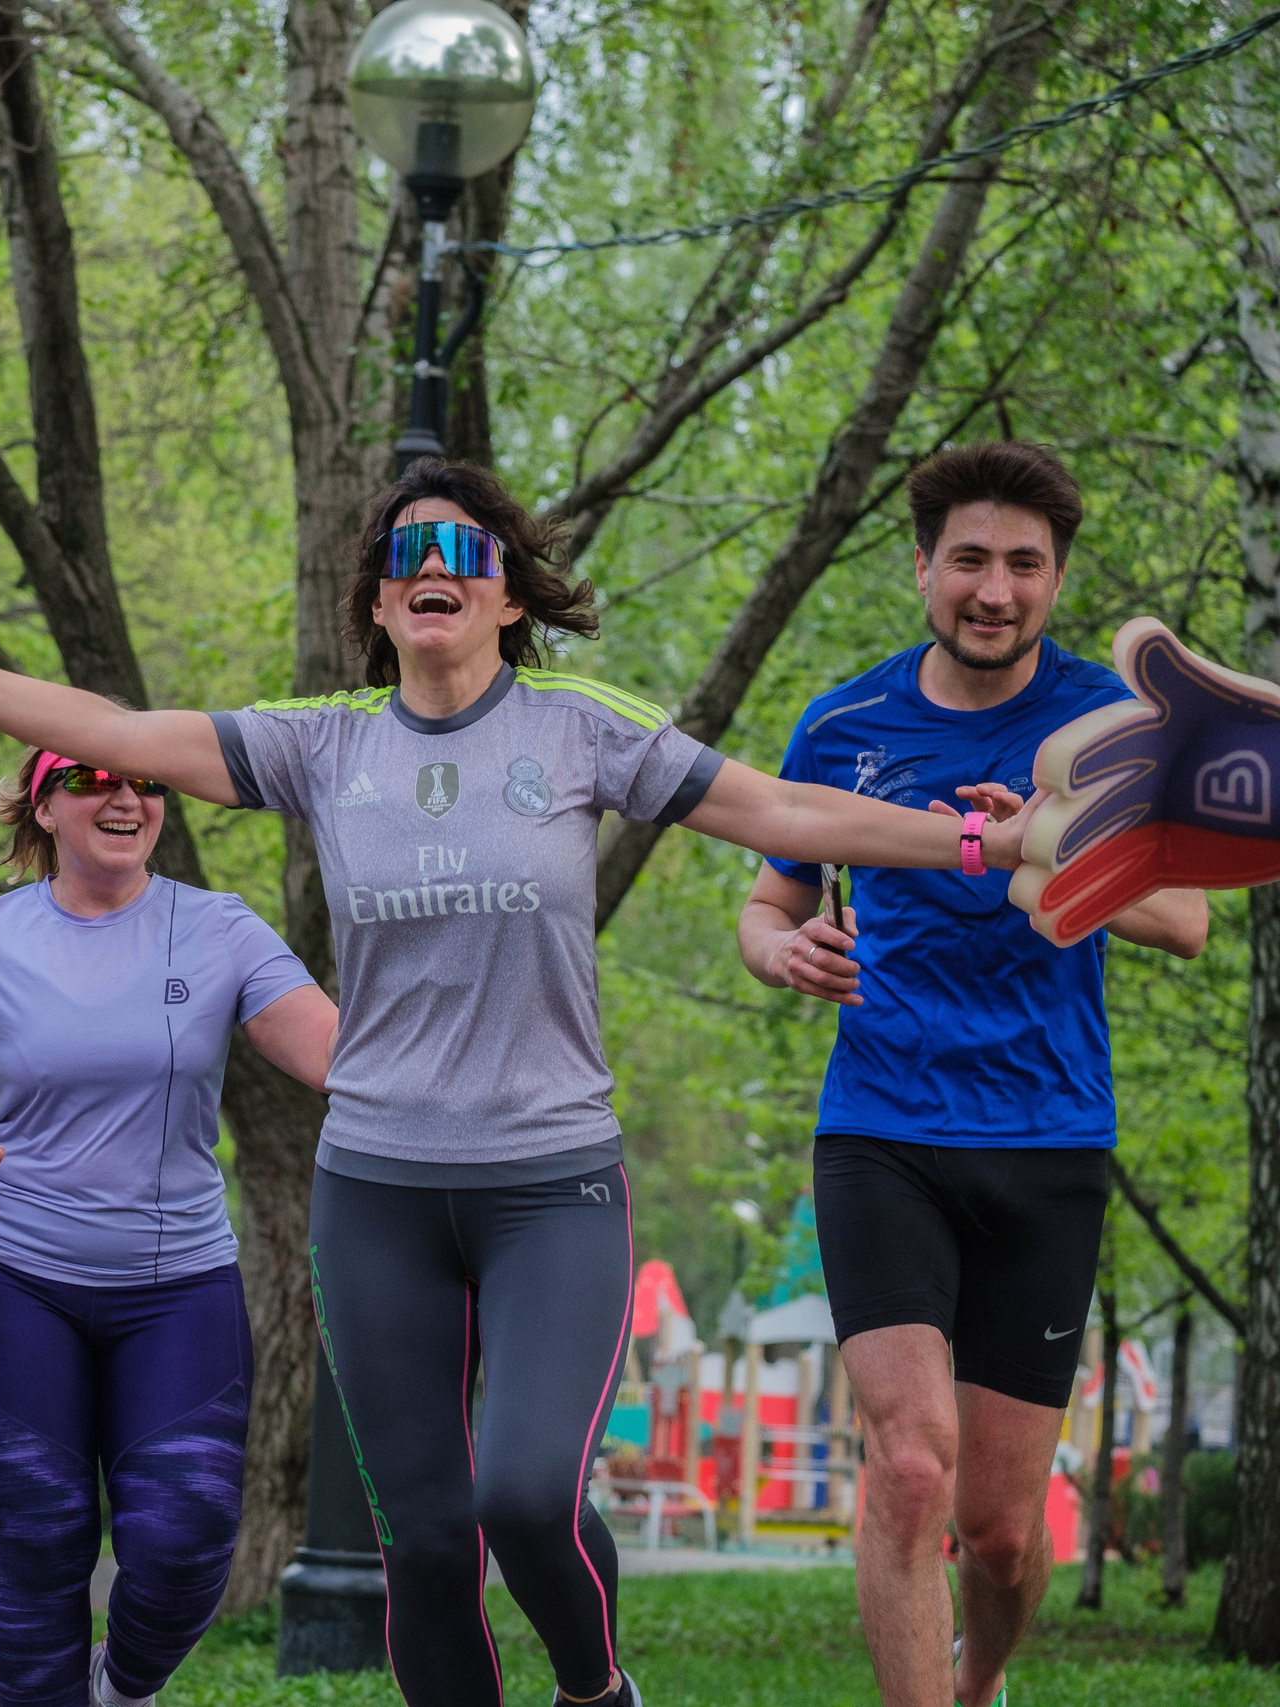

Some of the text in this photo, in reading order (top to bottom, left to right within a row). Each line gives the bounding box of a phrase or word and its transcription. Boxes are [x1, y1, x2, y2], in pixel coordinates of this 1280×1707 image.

[335, 791, 382, 807] adidas
[427, 796, 448, 805] FIFA
[418, 845, 467, 875] Fly
[346, 877, 540, 924] Emirates
